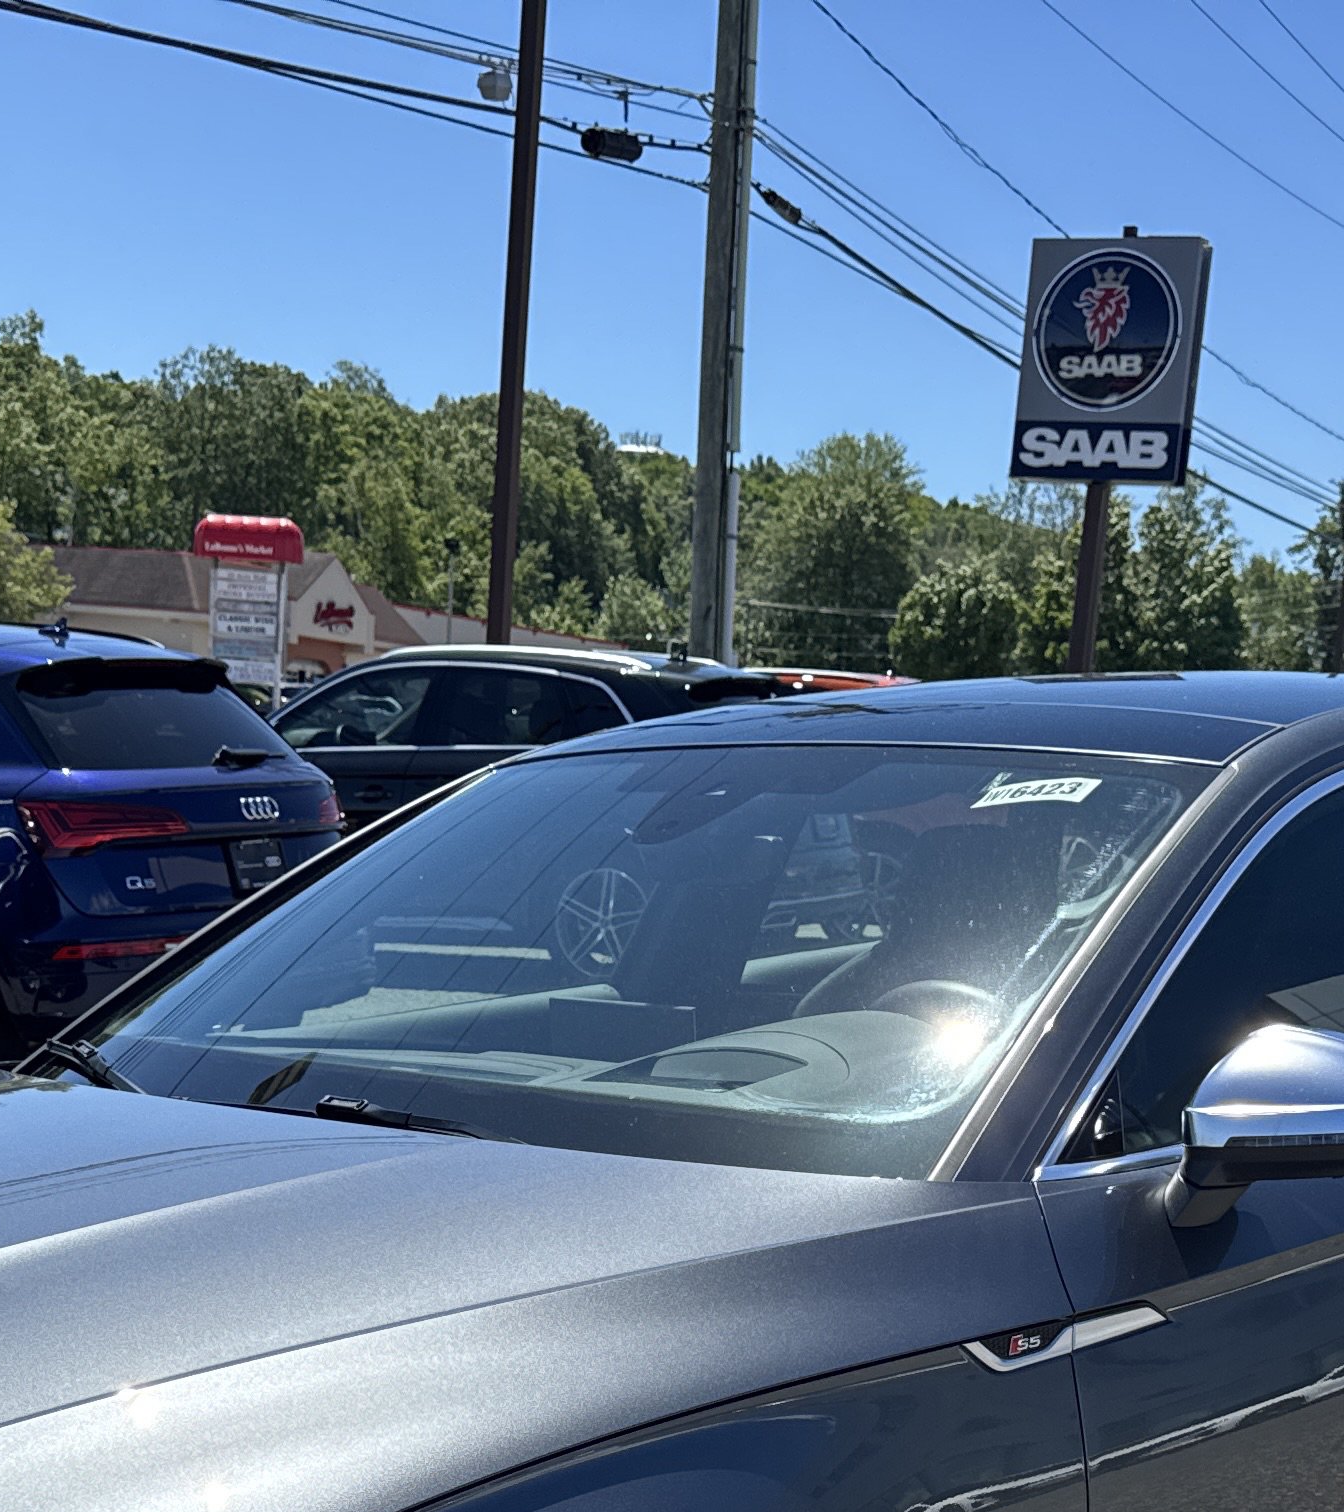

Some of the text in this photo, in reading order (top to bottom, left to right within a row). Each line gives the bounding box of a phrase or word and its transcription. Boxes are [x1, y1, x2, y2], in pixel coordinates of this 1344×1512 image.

[1058, 352, 1143, 379] SAAB
[1018, 427, 1169, 470] SAAB
[125, 876, 156, 890] Q5
[1018, 1335, 1041, 1350] S5
